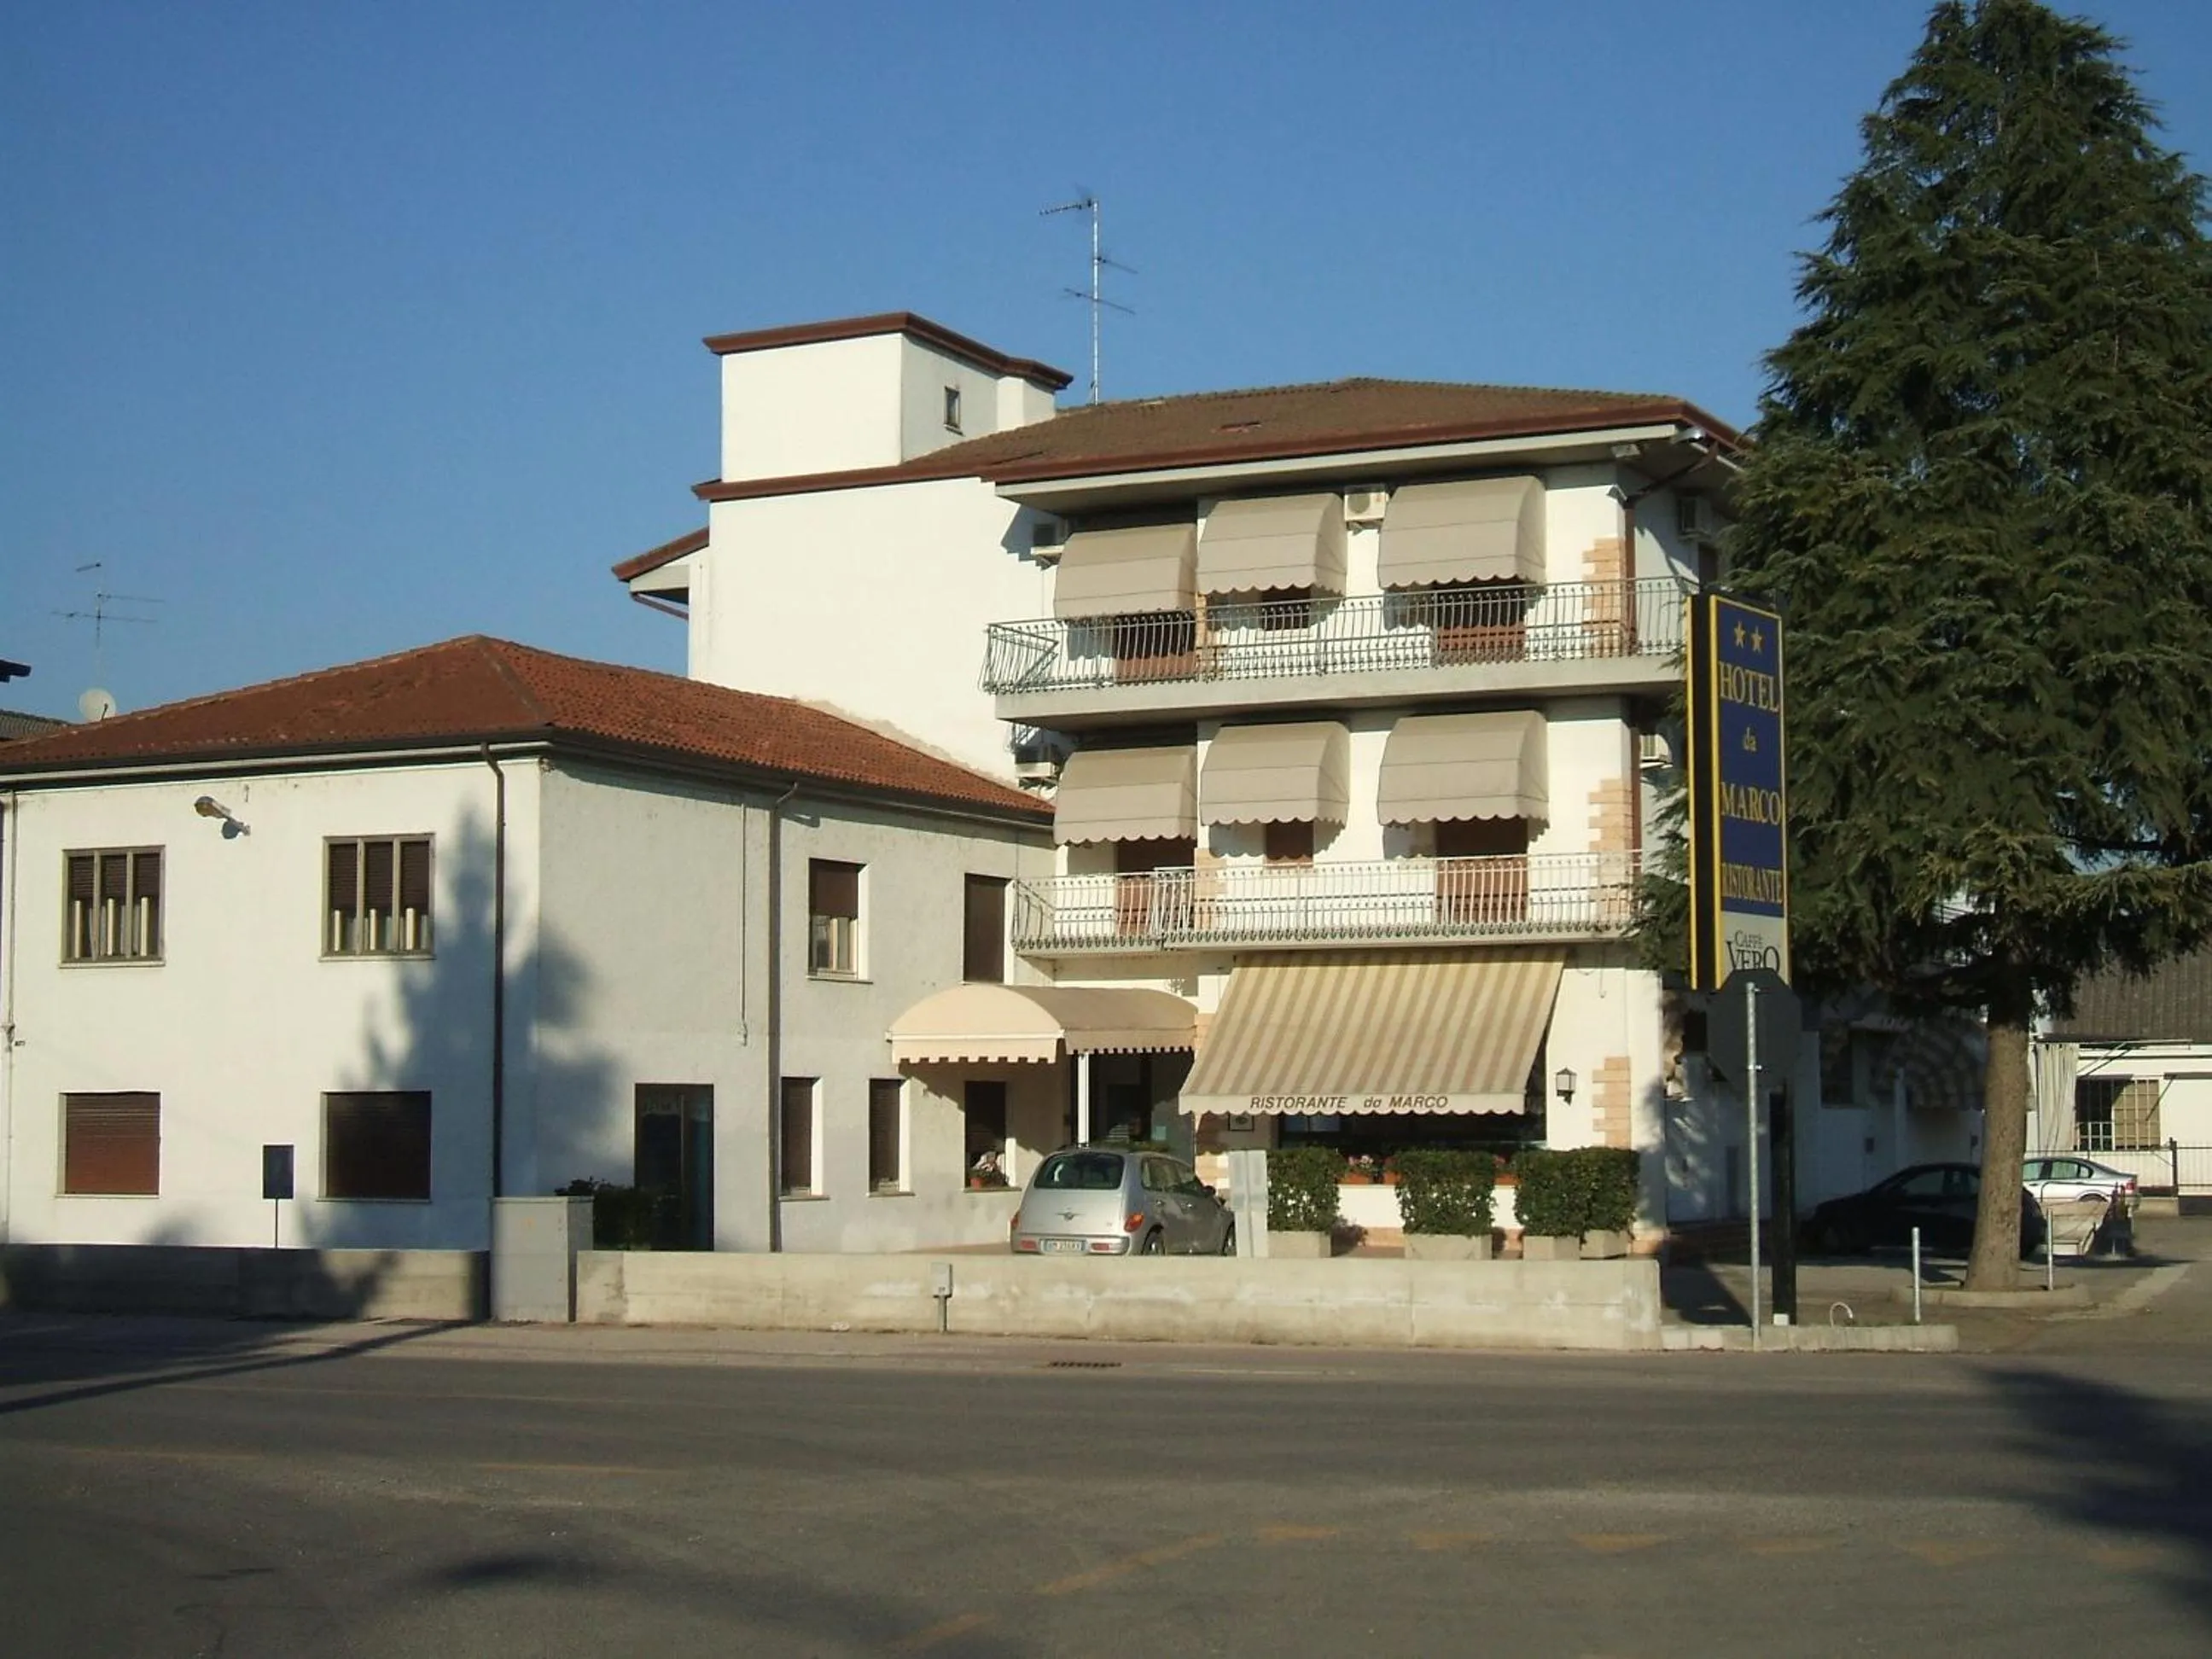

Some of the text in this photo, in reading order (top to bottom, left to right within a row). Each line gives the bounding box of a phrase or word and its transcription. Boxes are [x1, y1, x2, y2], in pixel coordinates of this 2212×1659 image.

[1719, 660, 1779, 713] HOTEL
[1720, 781, 1781, 825] MARCO
[1721, 862, 1783, 905] RISTORANTE
[1250, 1096, 1448, 1109] RISTORANTE da MARCO
